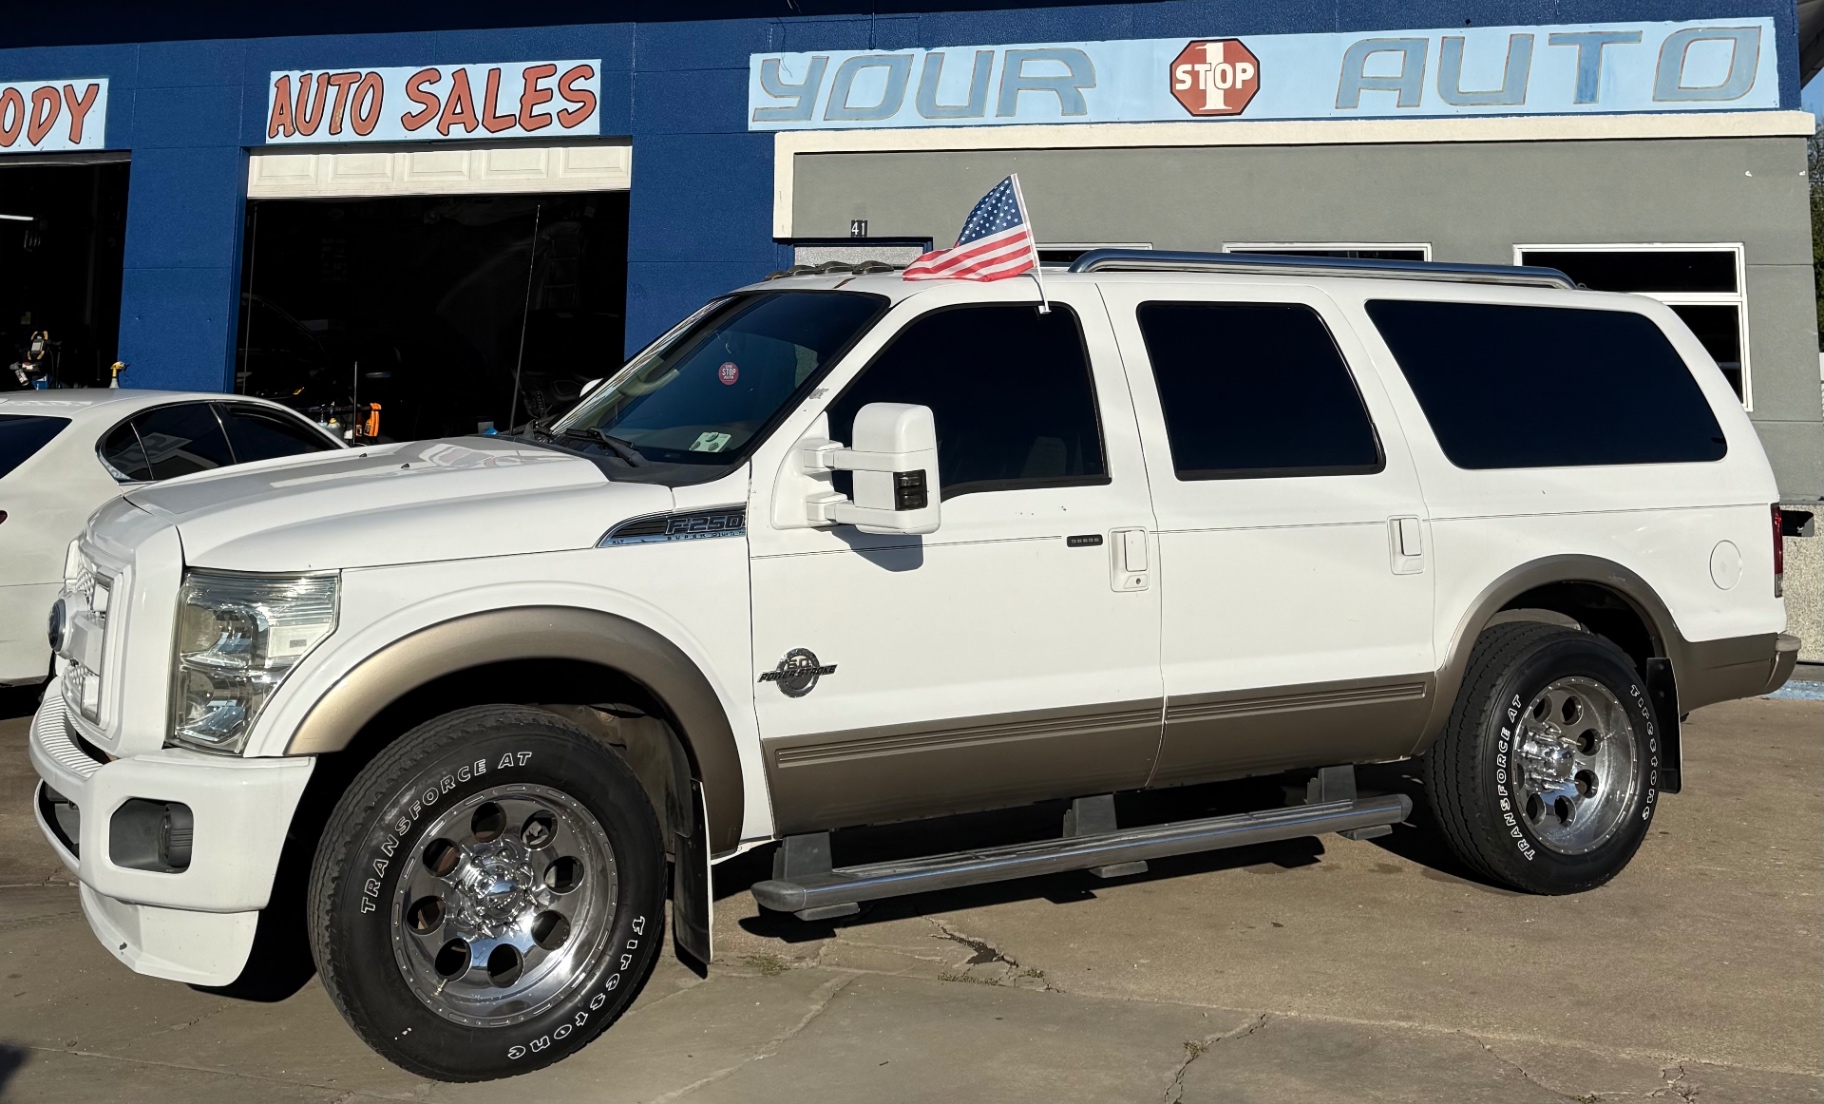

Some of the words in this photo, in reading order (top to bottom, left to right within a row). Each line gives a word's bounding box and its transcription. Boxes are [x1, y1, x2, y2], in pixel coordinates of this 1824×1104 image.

[268, 72, 384, 139] AUTO
[401, 64, 597, 136] SALES
[753, 48, 1096, 122] YOUR
[1175, 62, 1255, 90] STOP
[1335, 26, 1762, 109] AUTO
[851, 221, 865, 236] 41
[1507, 694, 1523, 723] AT
[360, 758, 487, 914] TRANSFORCE
[497, 751, 533, 769] AT
[1496, 727, 1536, 861] TRANSFORCE
